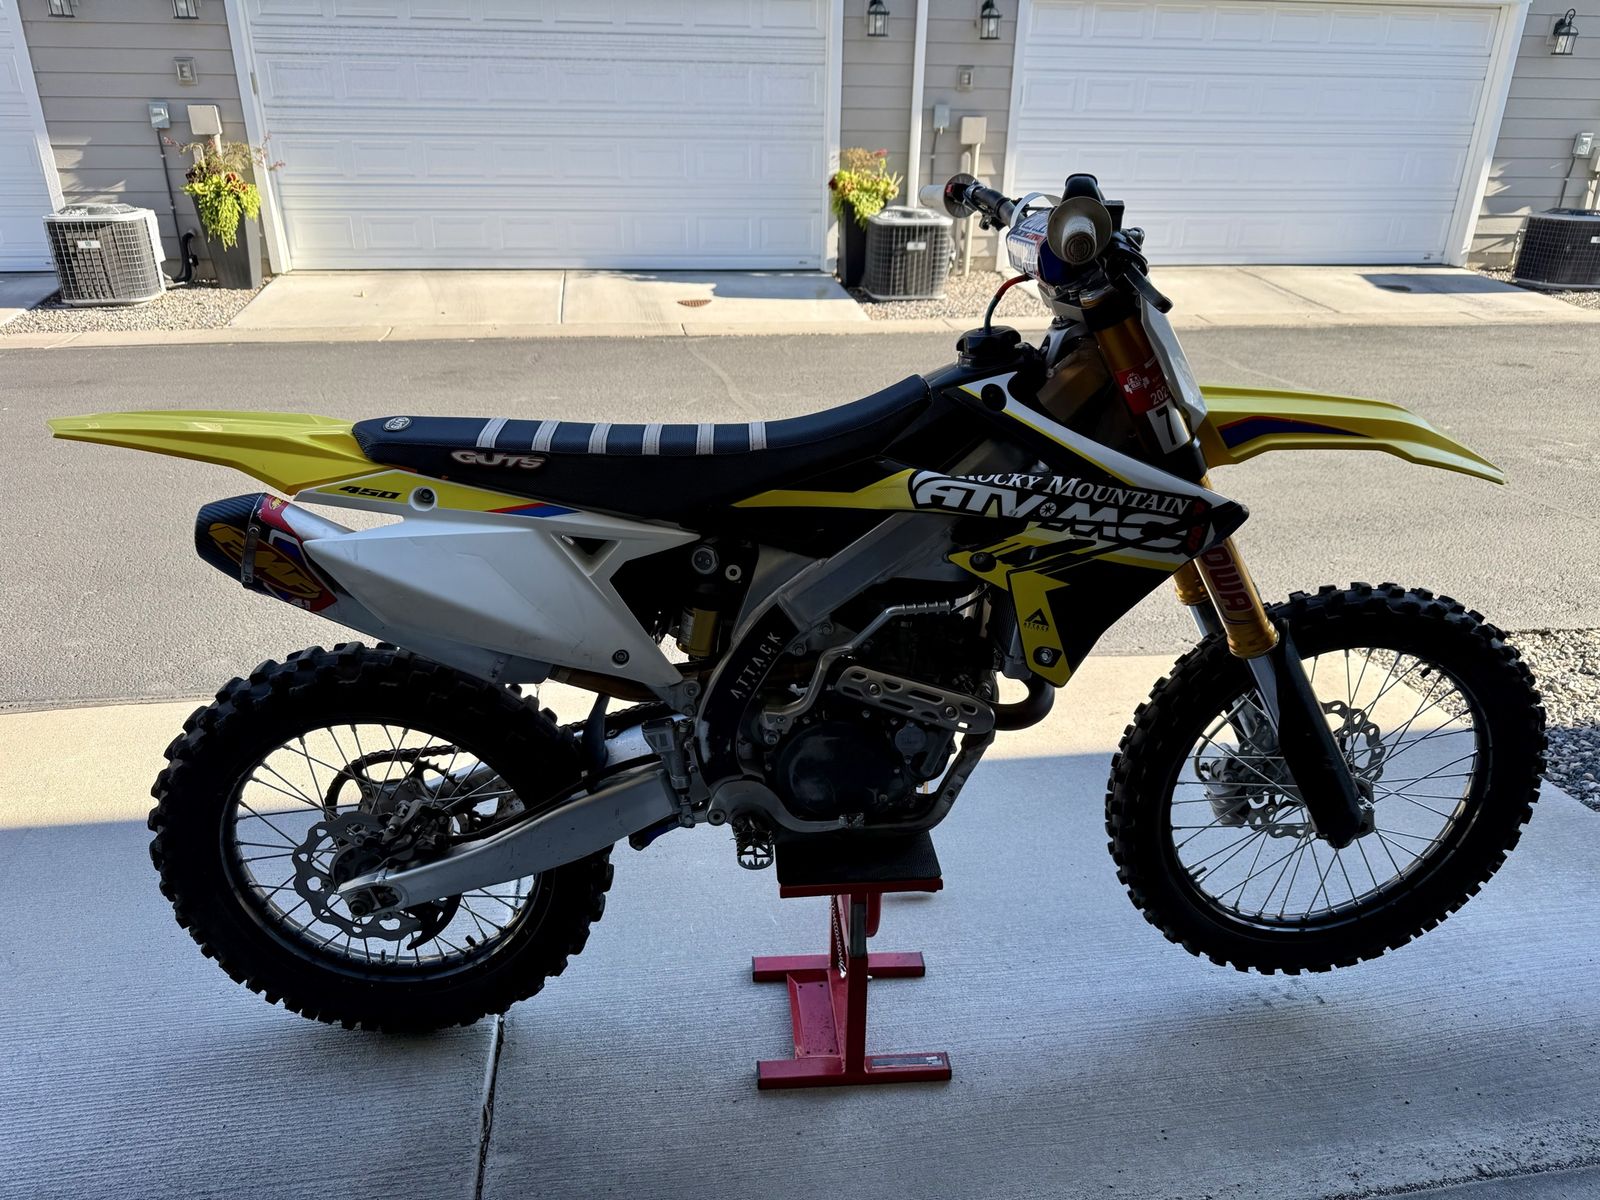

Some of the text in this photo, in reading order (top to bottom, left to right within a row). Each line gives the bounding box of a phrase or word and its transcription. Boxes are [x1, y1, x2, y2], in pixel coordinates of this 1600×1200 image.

[1150, 385, 1170, 405] 202
[1156, 405, 1177, 445] 7
[451, 449, 547, 470] GUTS
[338, 485, 403, 499] 450
[1043, 475, 1193, 516] MOUNTAIN
[729, 631, 782, 700] ATTACK
